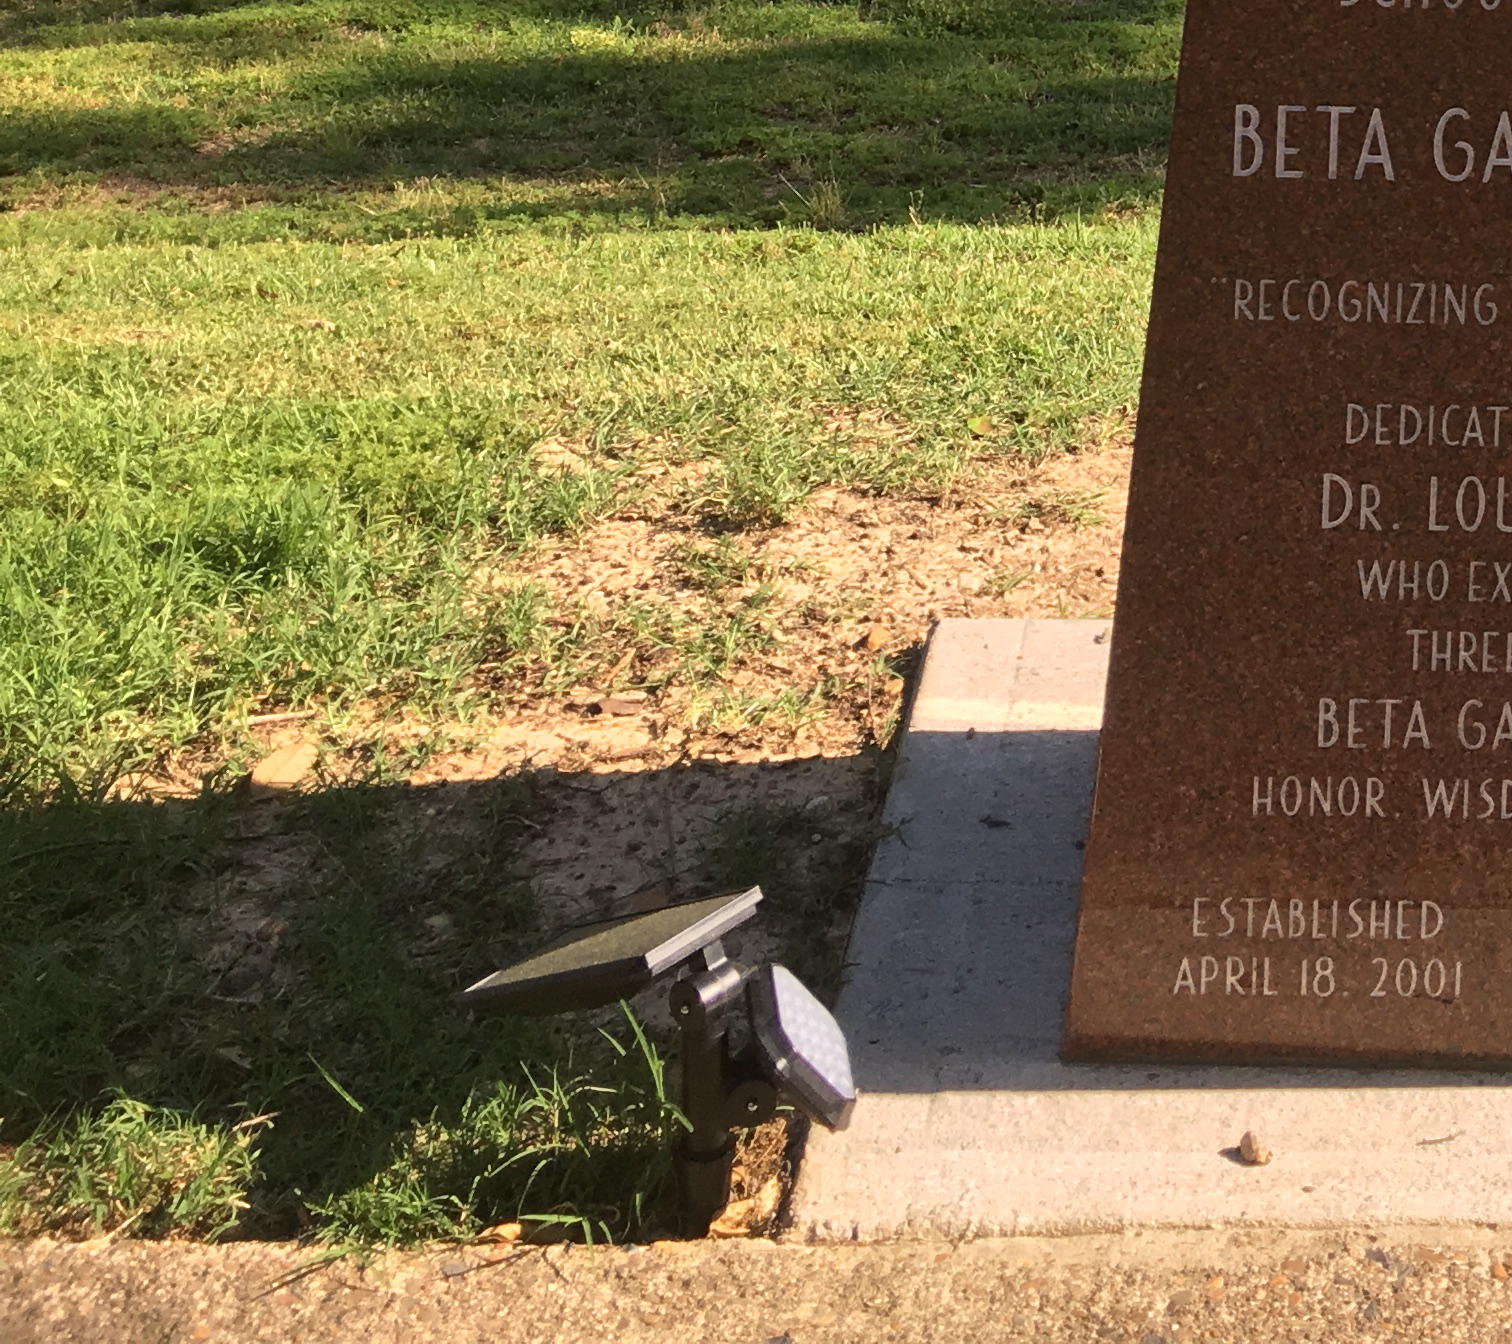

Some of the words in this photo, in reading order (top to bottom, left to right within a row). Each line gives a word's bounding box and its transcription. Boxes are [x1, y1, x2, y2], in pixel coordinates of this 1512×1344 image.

[1232, 105, 1395, 182] BETA
[1357, 560, 1450, 602] WHO
[1318, 698, 1432, 750] BETA
[1192, 897, 1444, 939] ESTABLISHED
[1173, 956, 1278, 996] APRIL
[1370, 957, 1463, 999] 2001
